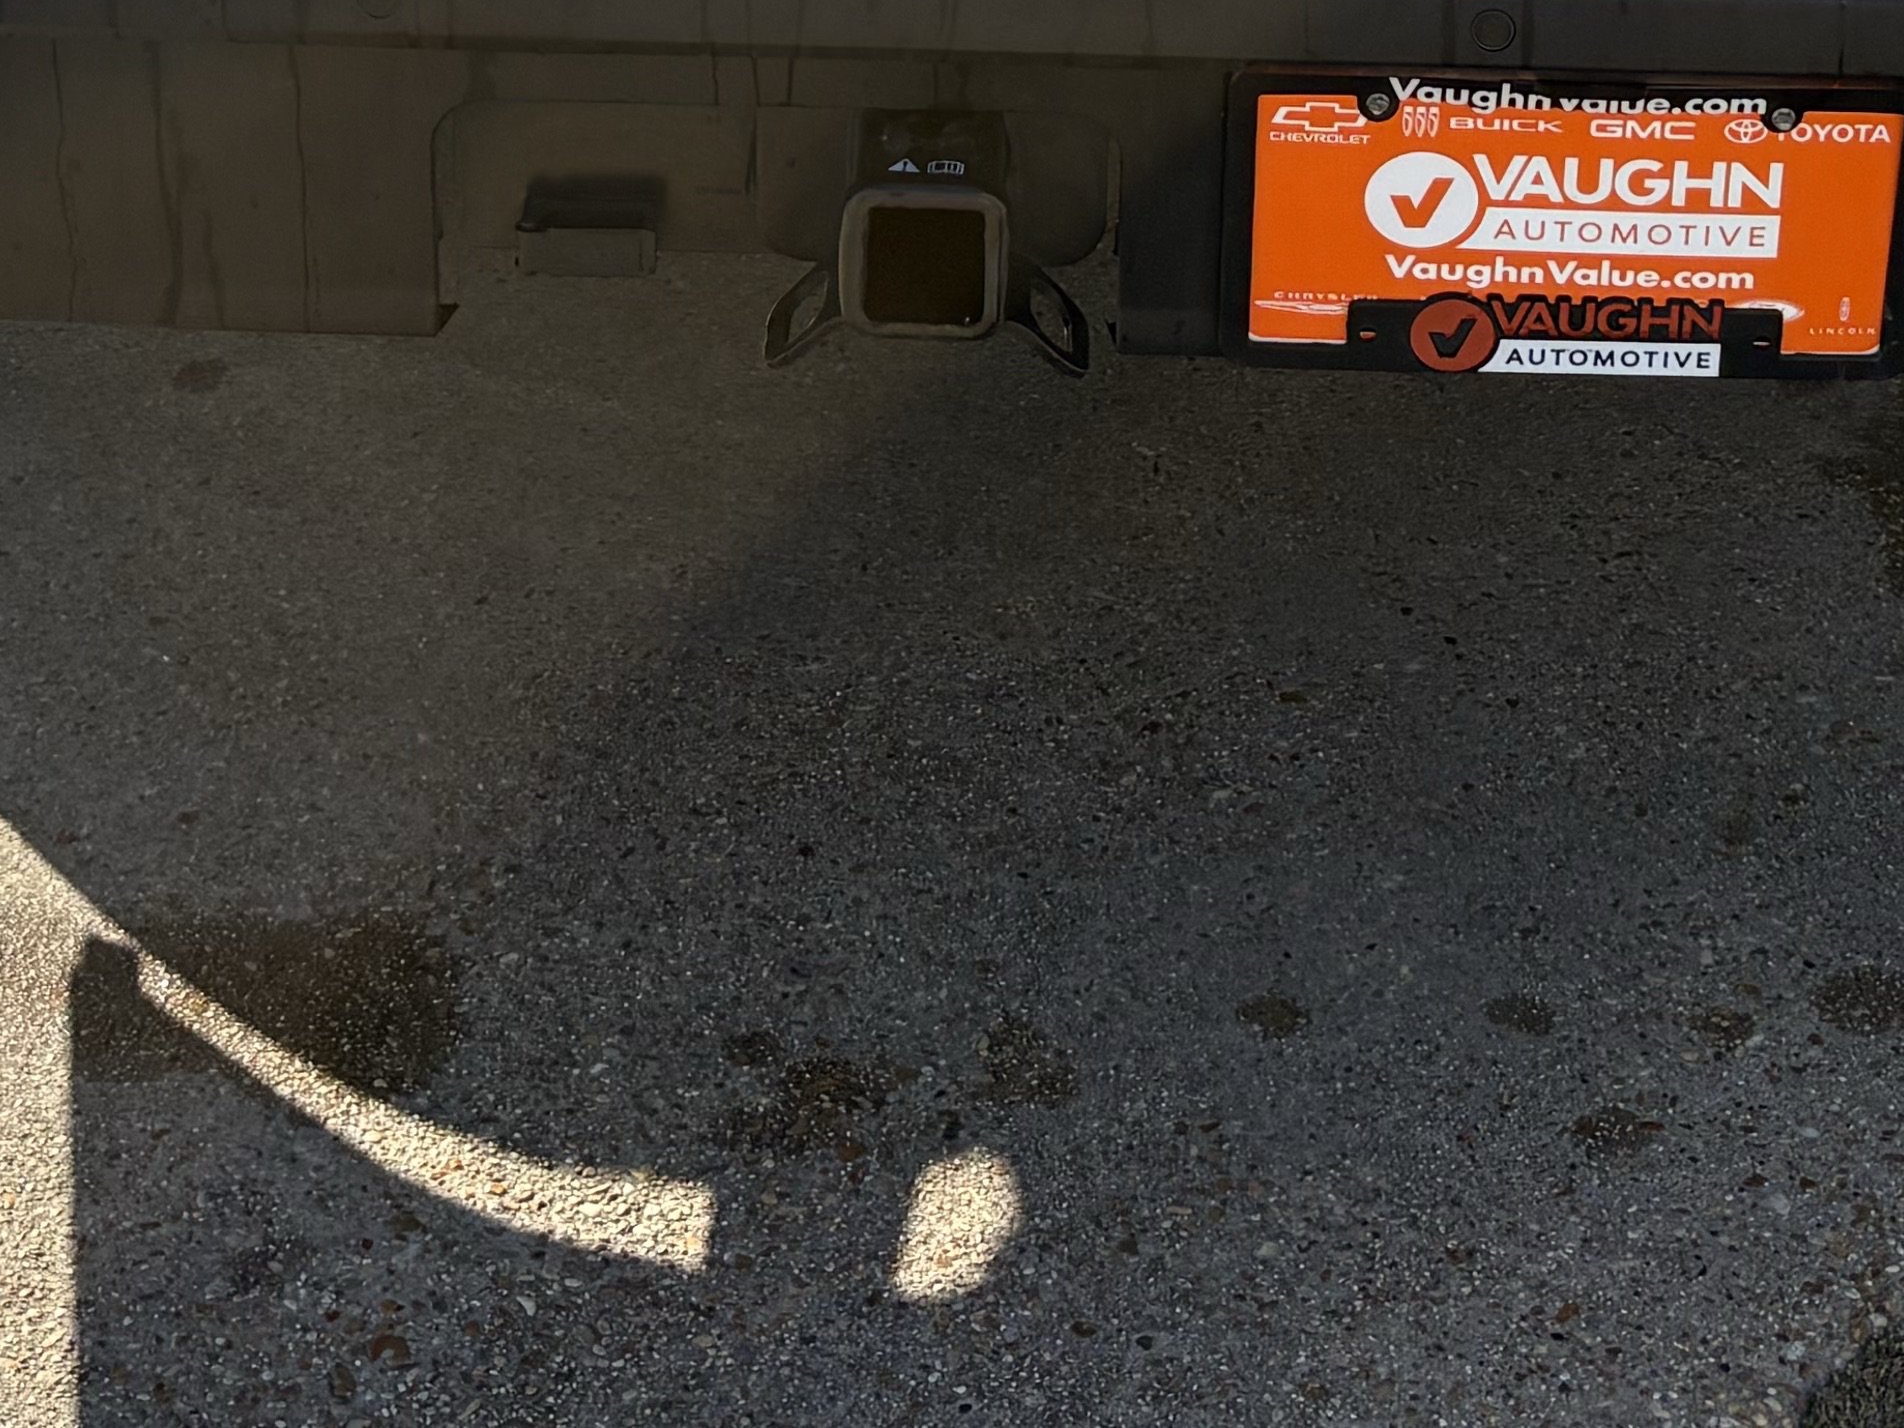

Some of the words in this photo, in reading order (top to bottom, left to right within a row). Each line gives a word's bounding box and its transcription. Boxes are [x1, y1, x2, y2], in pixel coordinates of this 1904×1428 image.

[1449, 116, 1563, 133] BUICK
[1589, 119, 1696, 141] GMC
[1269, 130, 1371, 144] CHEVROLET
[1474, 154, 1785, 210] VAUGHN
[1493, 219, 1768, 249] AUTOMOTIVE
[1384, 254, 1755, 290] VaughnValue.com
[1491, 299, 1724, 340] VAUGHN
[1808, 326, 1877, 336] LINCOLN
[1505, 348, 1712, 369] AUTOMOTIVE
